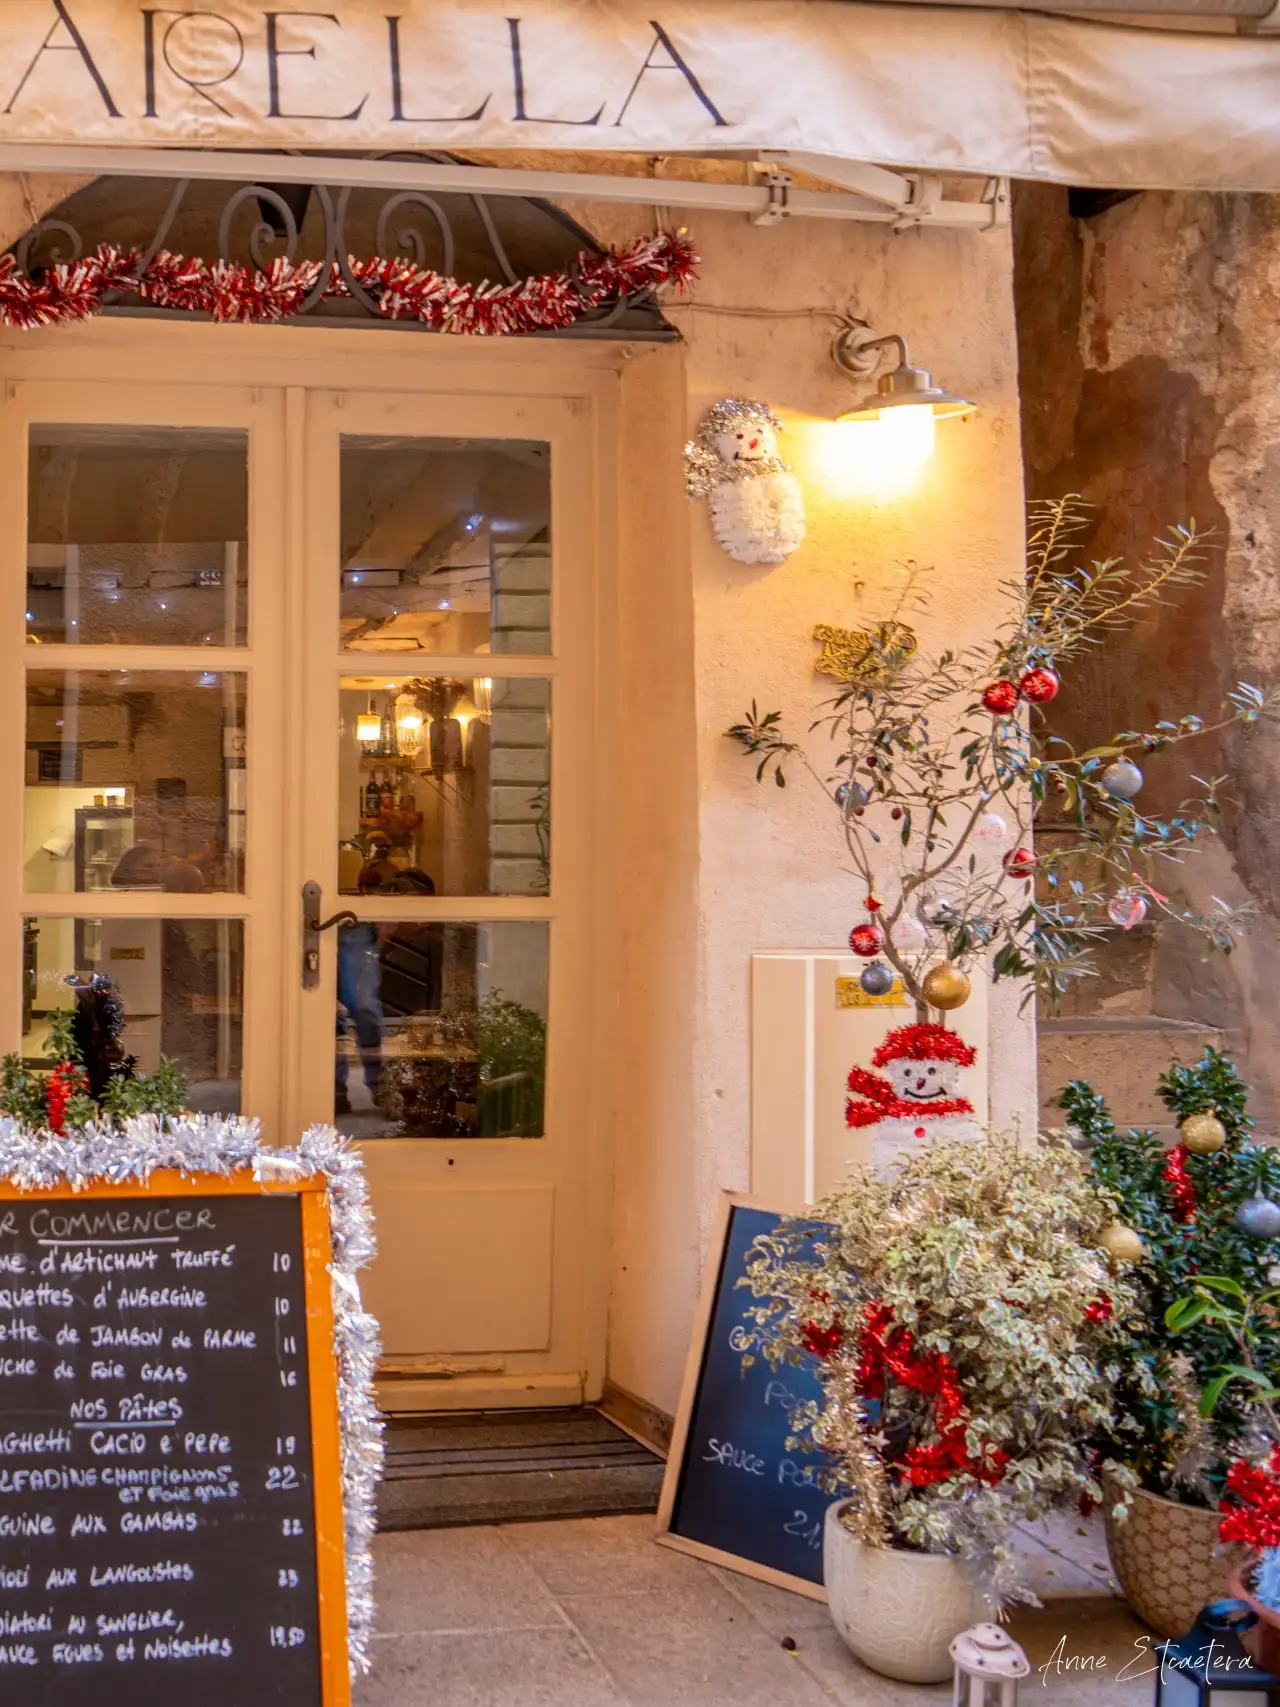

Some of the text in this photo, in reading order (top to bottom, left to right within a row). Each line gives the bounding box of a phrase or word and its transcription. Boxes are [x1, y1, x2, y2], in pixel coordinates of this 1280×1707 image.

[273, 1252, 291, 1273] 10
[274, 1296, 291, 1316] 10
[56, 1321, 81, 1346] de
[171, 1329, 193, 1349] de
[53, 1359, 76, 1380] de
[140, 1362, 188, 1383] GRAS
[70, 1398, 108, 1420] NOS
[160, 1435, 173, 1454] e
[264, 1464, 300, 1490] 22
[71, 1513, 108, 1538] AUX
[120, 1511, 198, 1534] GAMBAS
[45, 1567, 78, 1591] AUX
[68, 1614, 88, 1636] AU
